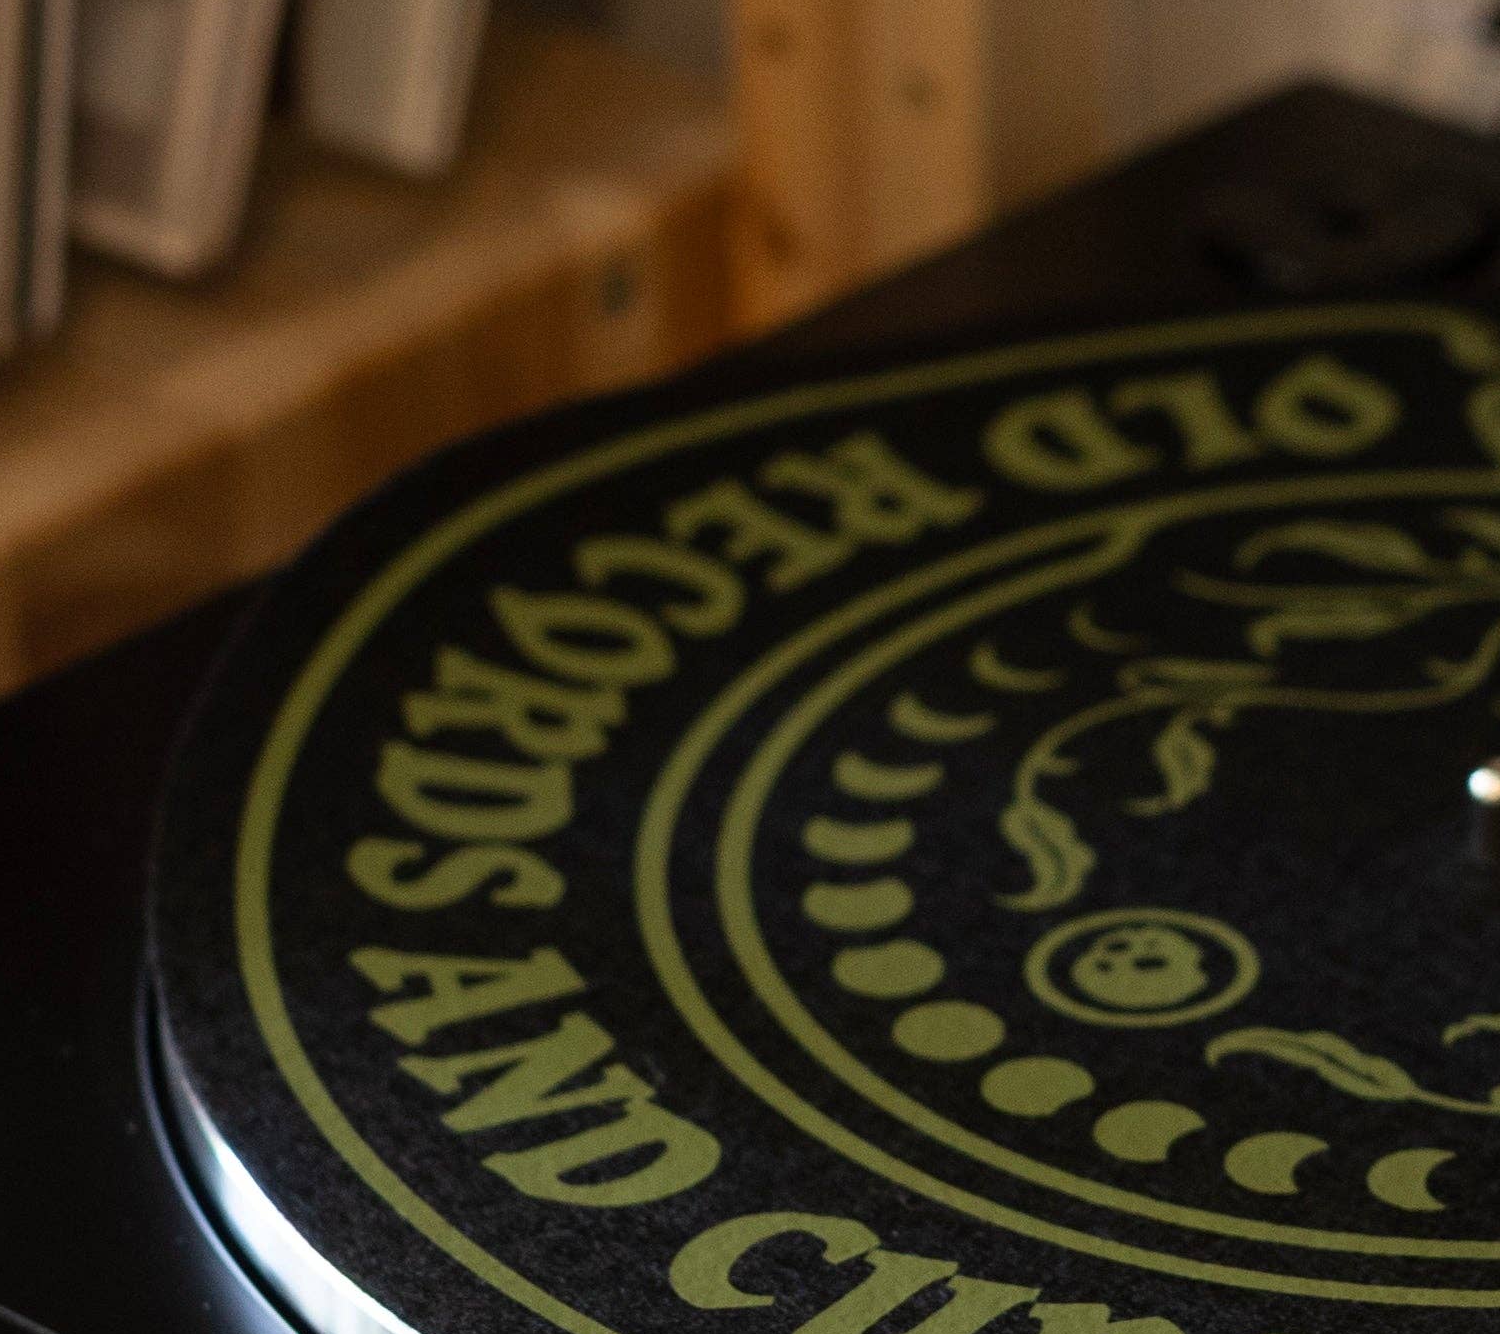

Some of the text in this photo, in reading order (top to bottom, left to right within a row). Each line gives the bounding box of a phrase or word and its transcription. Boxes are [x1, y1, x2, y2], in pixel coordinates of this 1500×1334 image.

[983, 355, 1400, 492] OLD
[346, 433, 984, 910] RECORDS
[350, 945, 723, 1208] AND
